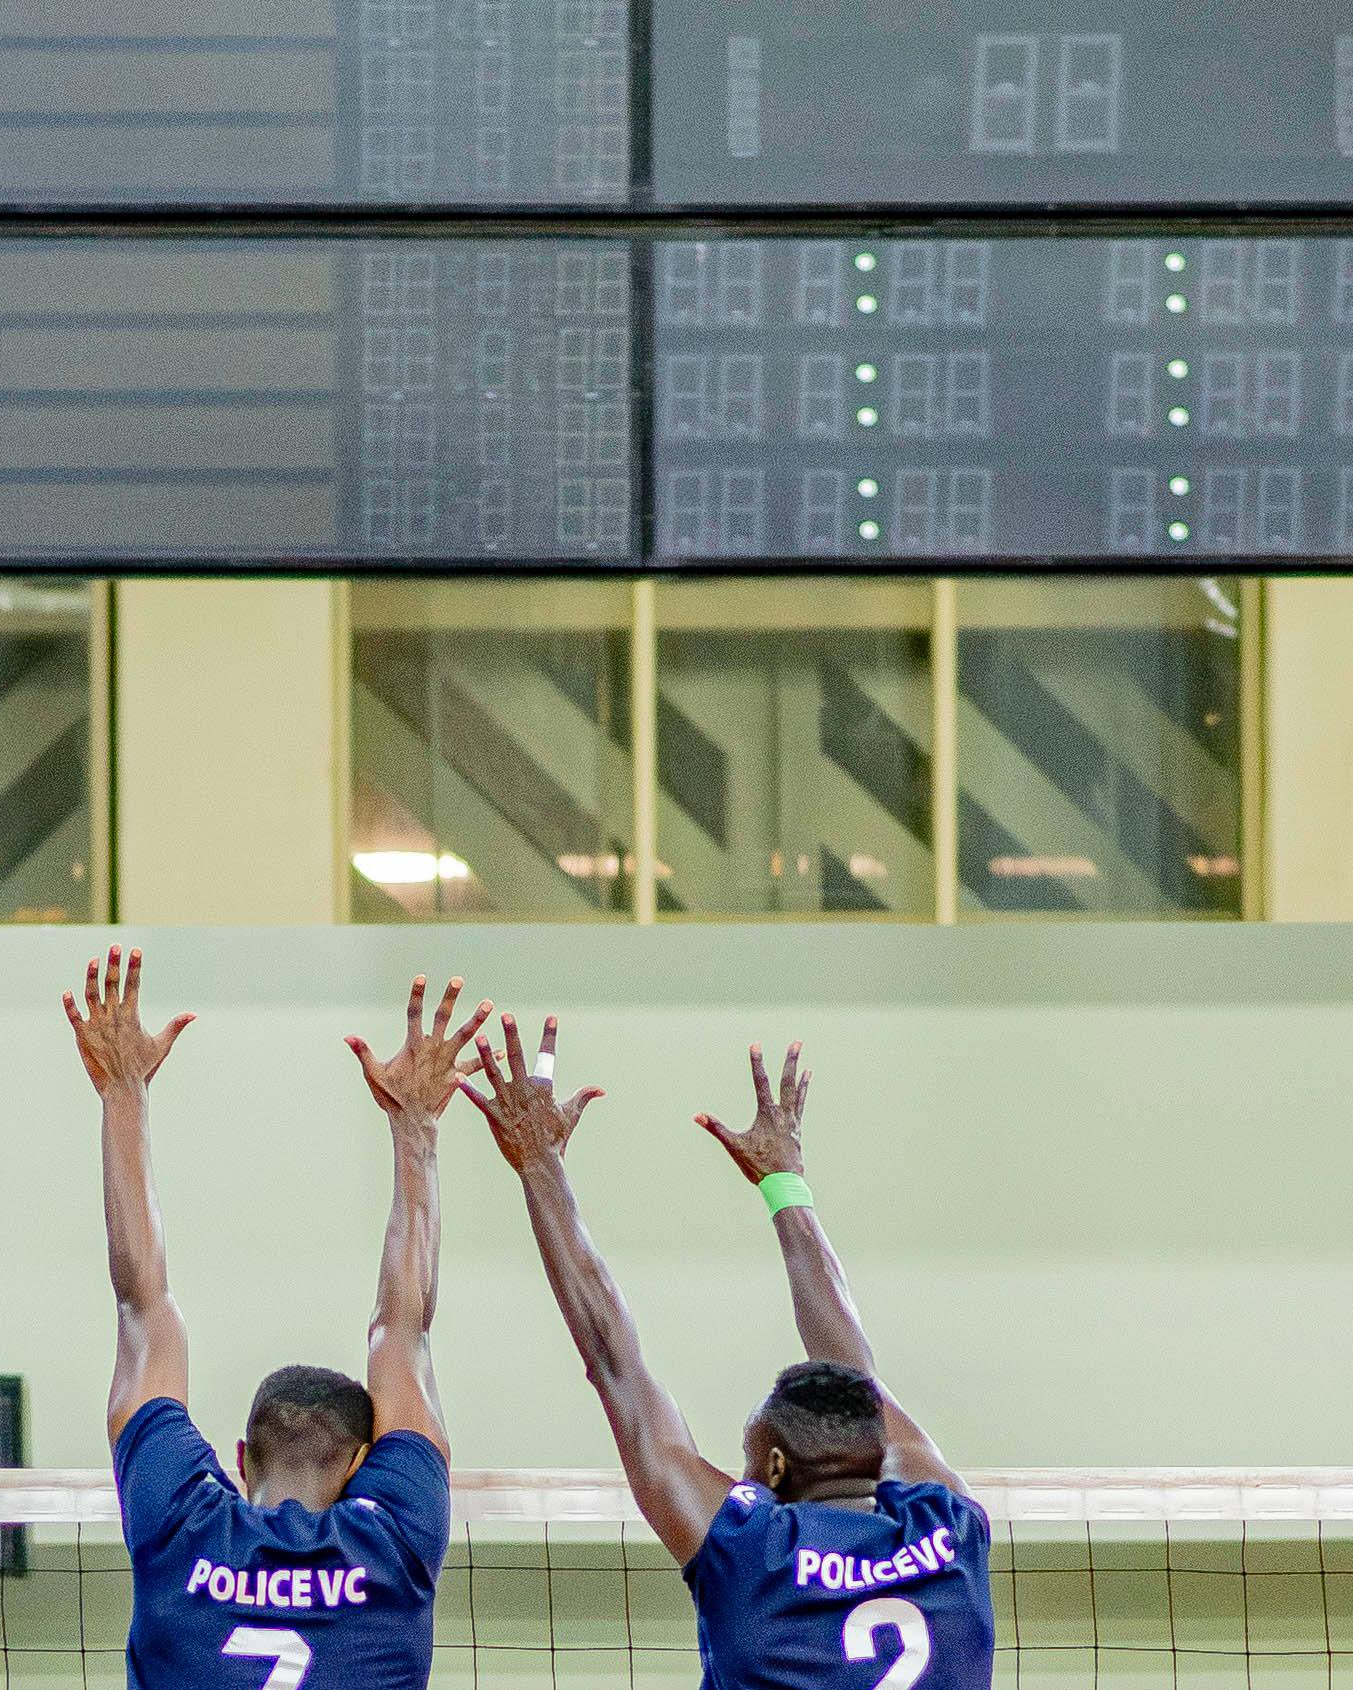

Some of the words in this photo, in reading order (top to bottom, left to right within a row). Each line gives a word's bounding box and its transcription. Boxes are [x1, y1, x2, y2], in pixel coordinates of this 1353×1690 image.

[186, 1558, 312, 1608] POLICE
[316, 1567, 368, 1607] VC
[796, 1548, 919, 1591] POLICE
[913, 1526, 956, 1573] VC
